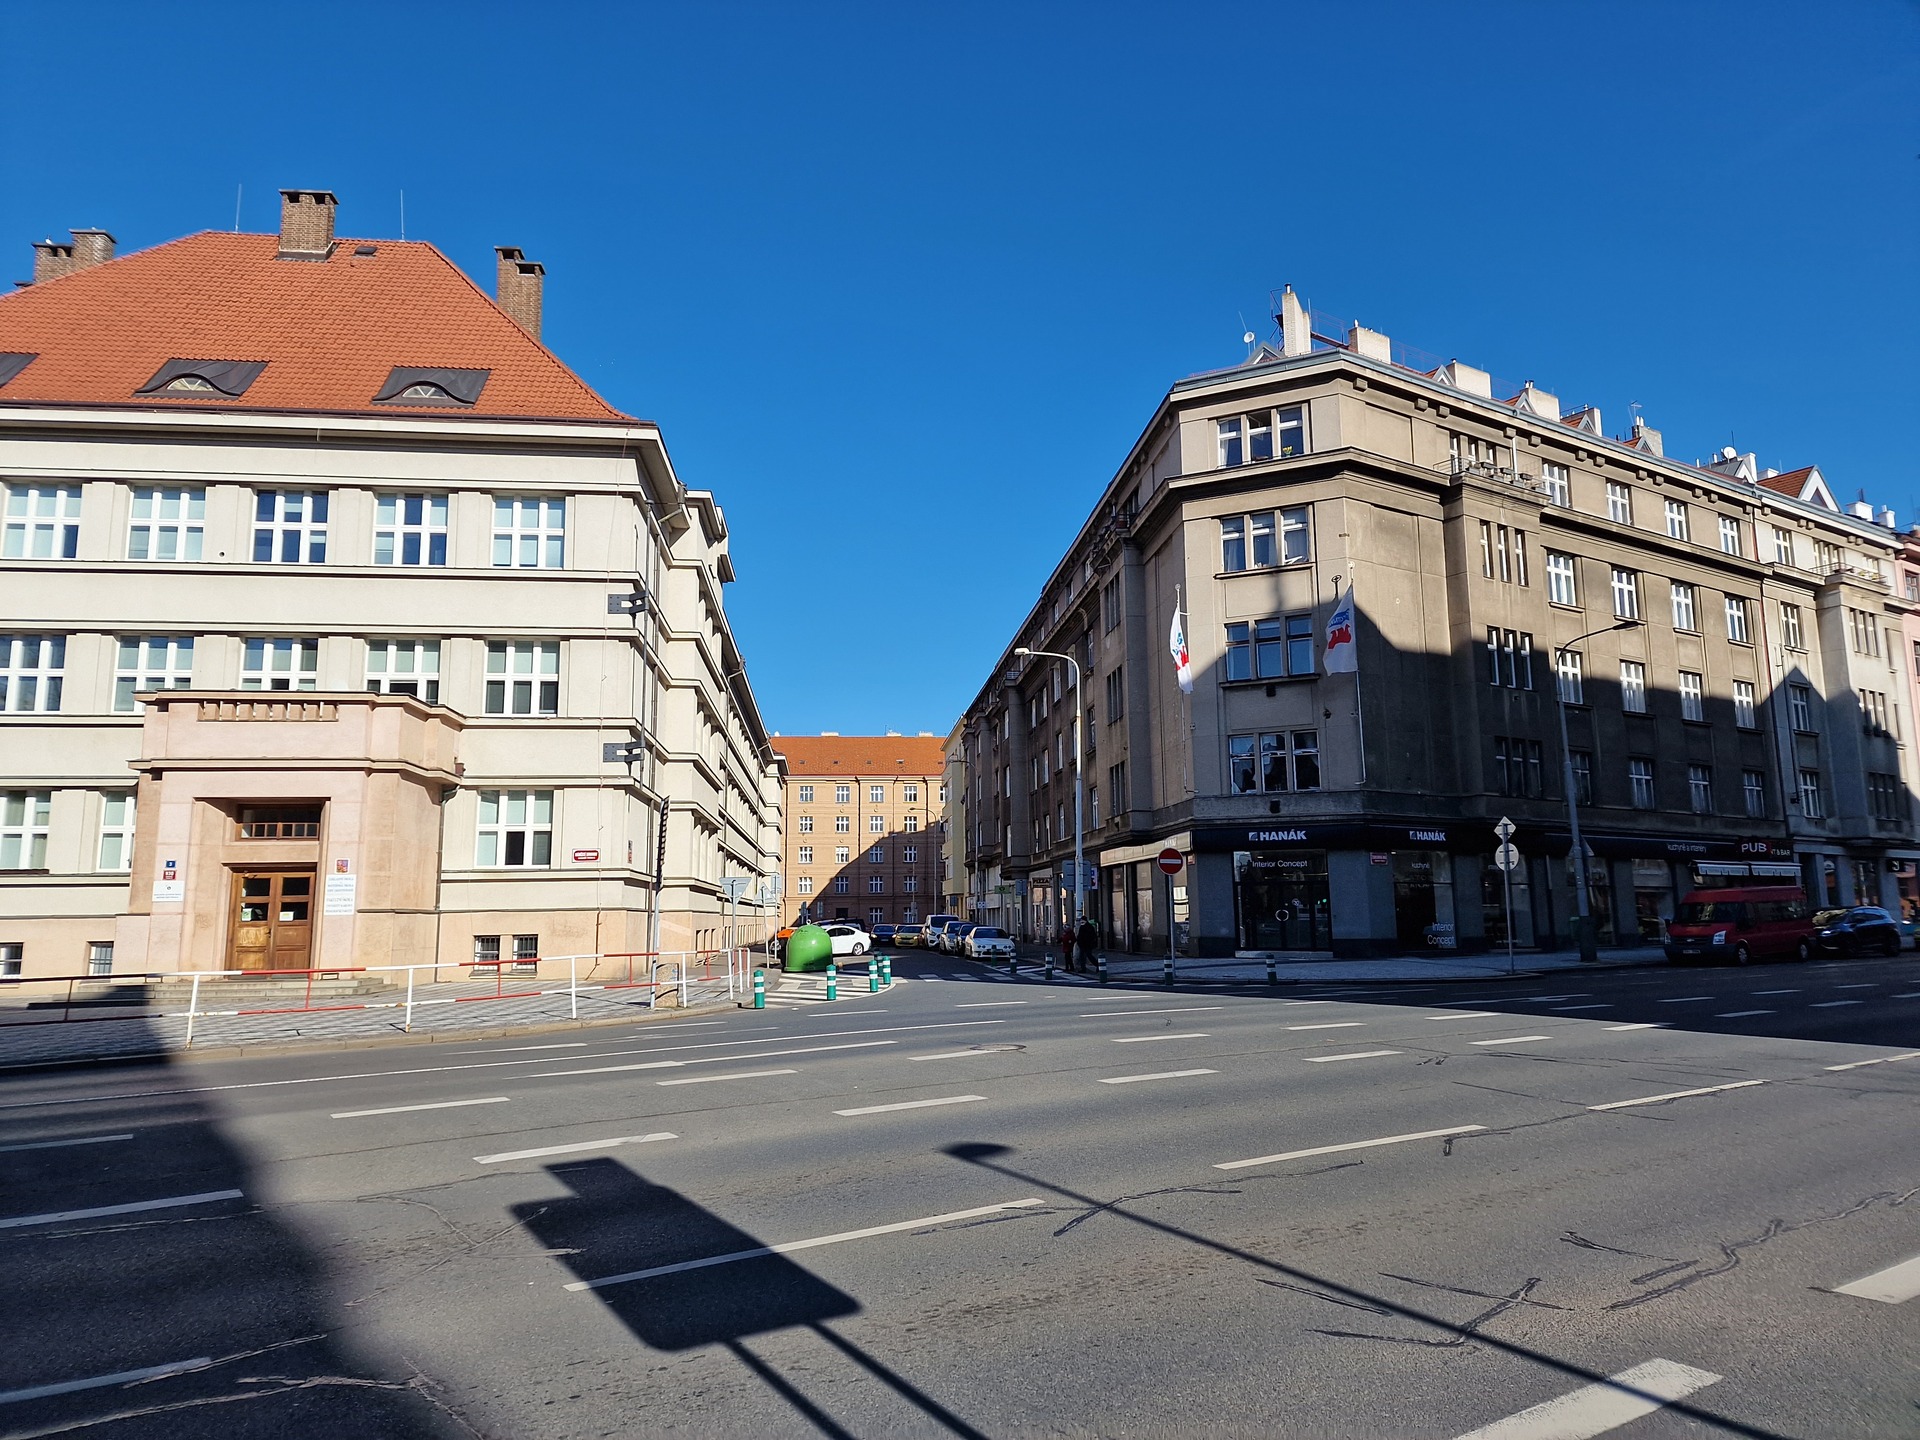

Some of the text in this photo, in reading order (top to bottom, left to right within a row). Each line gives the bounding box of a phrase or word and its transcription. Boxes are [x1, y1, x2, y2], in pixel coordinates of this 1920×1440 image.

[1260, 829, 1307, 841] HANÁK
[1416, 830, 1446, 841] HANÁK
[1741, 842, 1767, 853] PUB
[1252, 859, 1308, 868] Interior Concept
[1432, 922, 1455, 932] Interior
[1427, 934, 1455, 946] Concept
